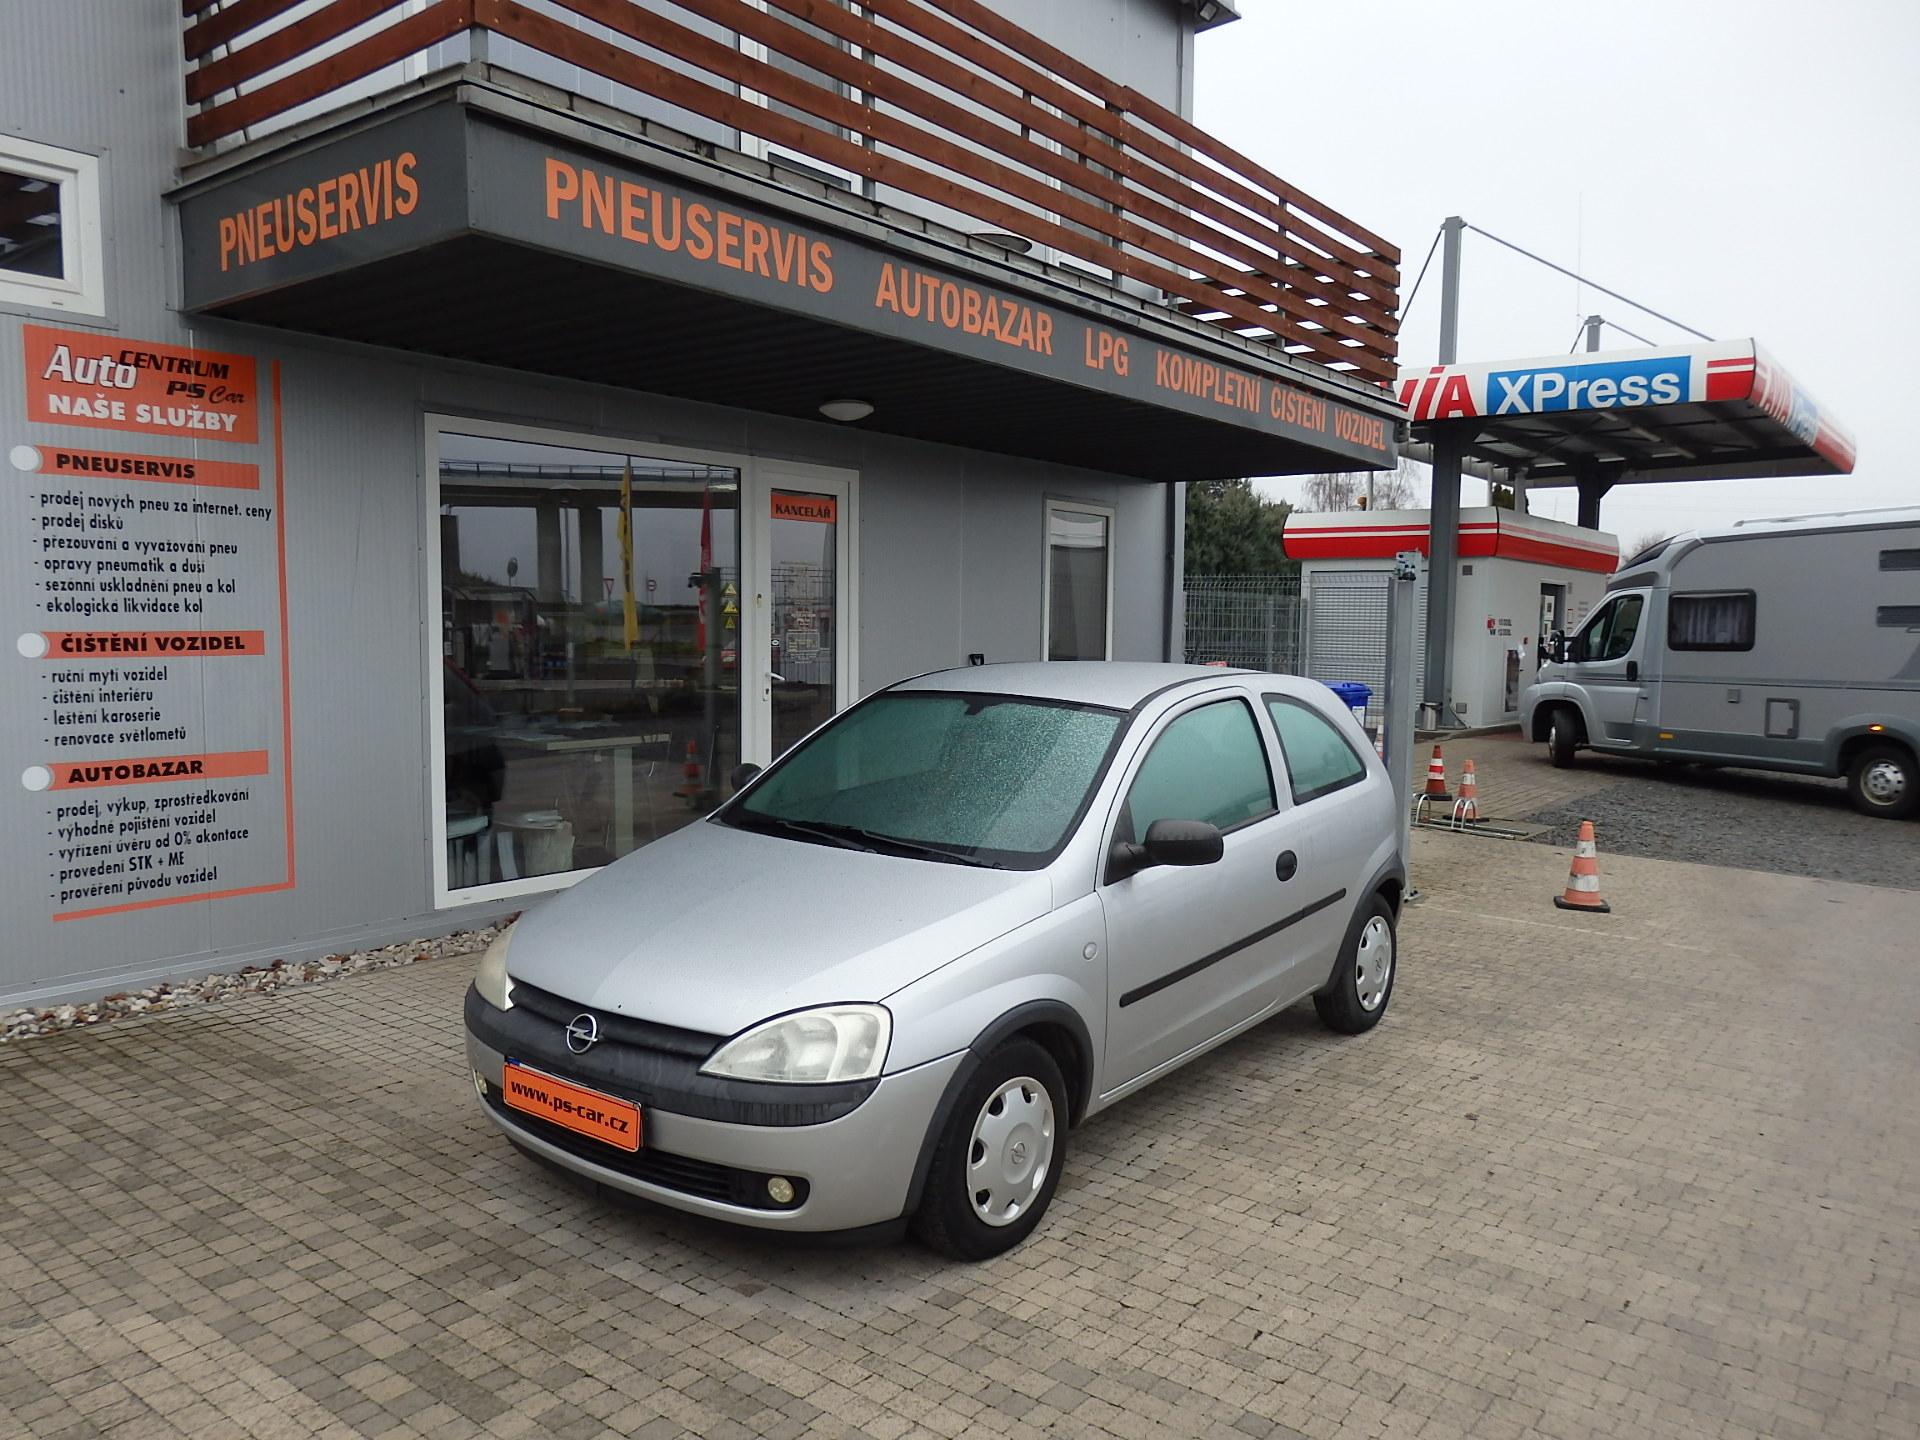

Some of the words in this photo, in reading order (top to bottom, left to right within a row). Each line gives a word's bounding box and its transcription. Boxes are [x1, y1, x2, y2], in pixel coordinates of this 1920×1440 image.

[219, 152, 419, 271] PNEUSERVIS
[544, 157, 834, 293] PNEUSERVIS
[875, 262, 1053, 355] AUTOBAZAR
[1085, 327, 1128, 377] LPG
[1156, 351, 1263, 414] KOMPLETNÍ
[1334, 407, 1386, 451] VOZIDEL
[42, 344, 138, 389] Auto
[119, 350, 229, 380] CENTRUM
[166, 380, 207, 399] PS
[209, 385, 245, 404] Car
[1495, 369, 1680, 415] XPress
[49, 393, 126, 421] NAŠE
[136, 404, 237, 432] SLUŽBY
[56, 453, 196, 479] PNEUSERVIS
[41, 490, 84, 510] prodej
[88, 494, 135, 512] nových
[140, 500, 169, 513] pneu
[174, 502, 188, 513] za
[193, 498, 242, 516] internet.
[246, 507, 272, 521] ceny
[42, 512, 85, 532] prodej
[89, 513, 124, 530] disků
[43, 534, 117, 553] přezouvání
[122, 541, 129, 551] a
[134, 540, 205, 555] vyvažování
[210, 544, 238, 557] pneu
[44, 560, 92, 574] opravy
[97, 557, 165, 574] pneumatik
[170, 562, 177, 572] a
[182, 558, 205, 573] duší
[45, 578, 96, 592] sezónní
[100, 577, 169, 592] uskladnění
[173, 583, 202, 596] pneu
[206, 583, 213, 593] a
[218, 578, 235, 593] kol
[46, 597, 119, 616] ekologická
[124, 597, 180, 613] likvidace
[184, 597, 203, 613] kol
[61, 633, 147, 652] ČIŠTĚNÍ
[155, 636, 245, 651] VOZIDEL
[52, 668, 84, 683] ruční
[124, 665, 168, 681] vozidel
[53, 688, 94, 704] čištění
[99, 687, 153, 703] interiéru
[54, 709, 97, 725] leštění
[102, 706, 161, 723] karoserie
[55, 733, 115, 746] renovace
[120, 726, 186, 743] světlometů
[68, 760, 203, 784] AUTOBAZAR
[107, 797, 149, 816] výkup,
[154, 788, 249, 812] zprostředkování
[58, 820, 114, 842] výhodné
[120, 814, 170, 836] pojištění
[174, 808, 216, 826] vozidel
[59, 841, 112, 862] vyřízení
[116, 839, 151, 853] úvěru
[156, 833, 170, 847] od
[174, 831, 192, 846] 0%
[196, 829, 249, 844] akontace
[60, 860, 125, 884] provedení
[129, 855, 152, 872] STK
[168, 851, 185, 867] ME
[60, 880, 123, 904] prověření
[127, 872, 172, 895] původu
[176, 866, 217, 885] vozidel
[511, 1080, 630, 1134] www.ps-car.cz
